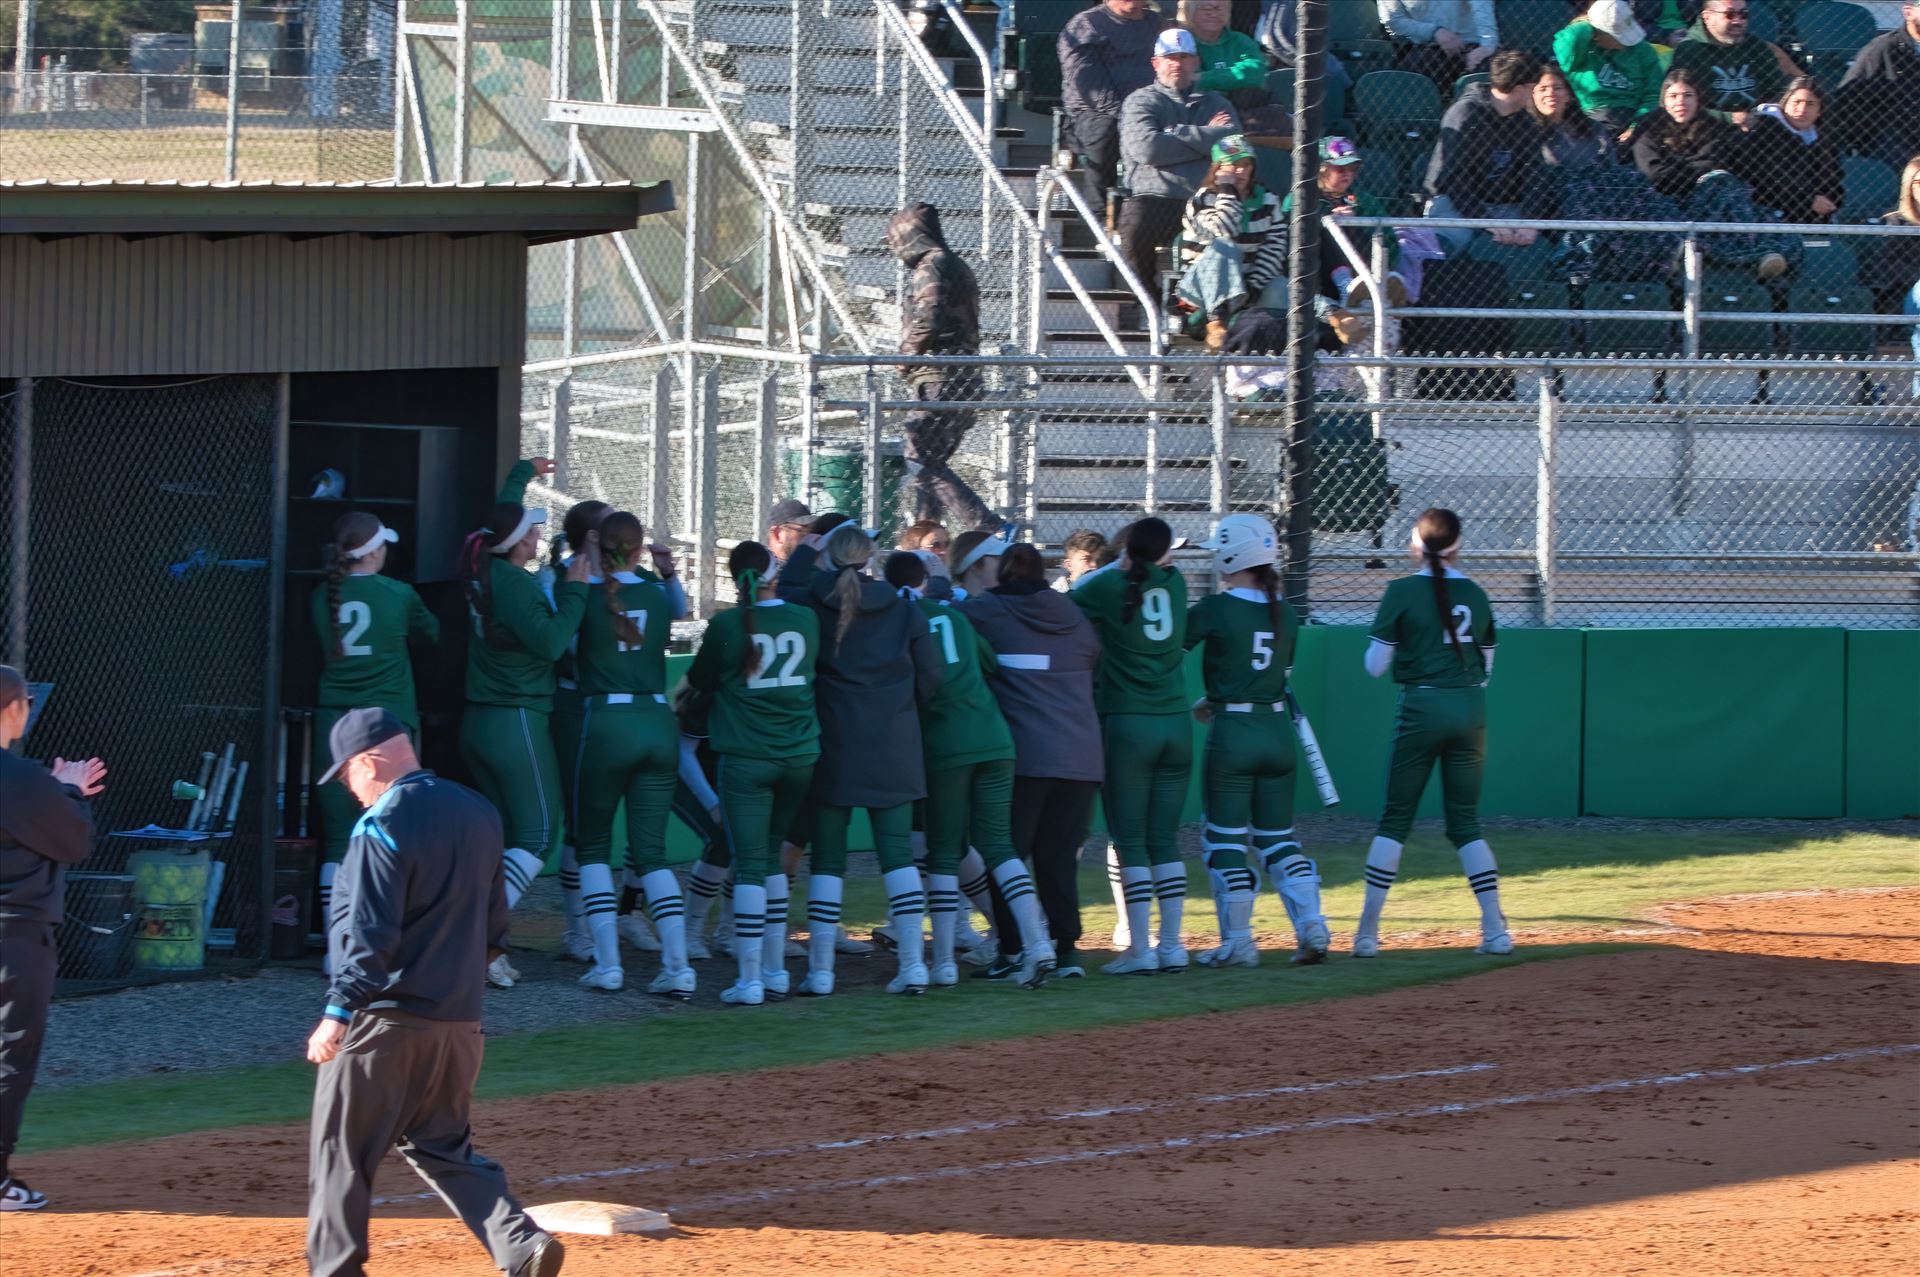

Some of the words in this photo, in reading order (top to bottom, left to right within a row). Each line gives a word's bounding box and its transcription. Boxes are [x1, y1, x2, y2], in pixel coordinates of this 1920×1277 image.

[338, 600, 373, 657] 2
[1141, 588, 1174, 641] 9
[747, 631, 807, 689] 22
[1250, 630, 1275, 671] 5
